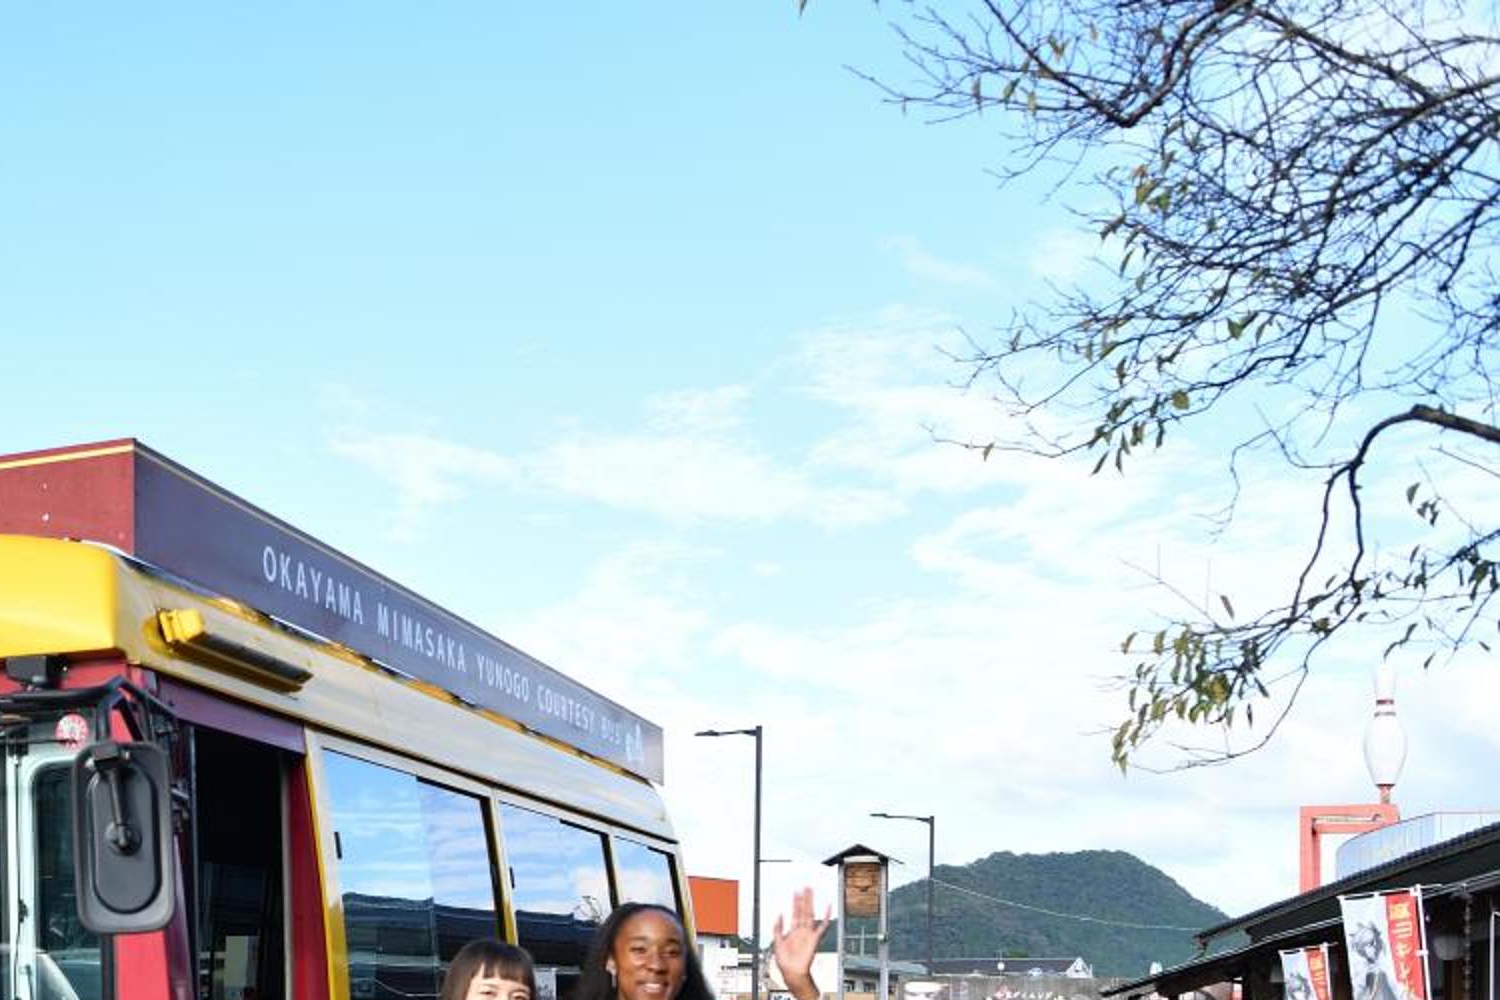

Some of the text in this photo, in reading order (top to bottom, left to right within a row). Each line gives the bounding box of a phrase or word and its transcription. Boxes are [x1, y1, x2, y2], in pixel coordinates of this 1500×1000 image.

[262, 545, 364, 625] OKAYAMA
[377, 602, 467, 672] MIMASAKA
[477, 653, 530, 702] YUNOGO
[537, 683, 596, 734] COURTESY
